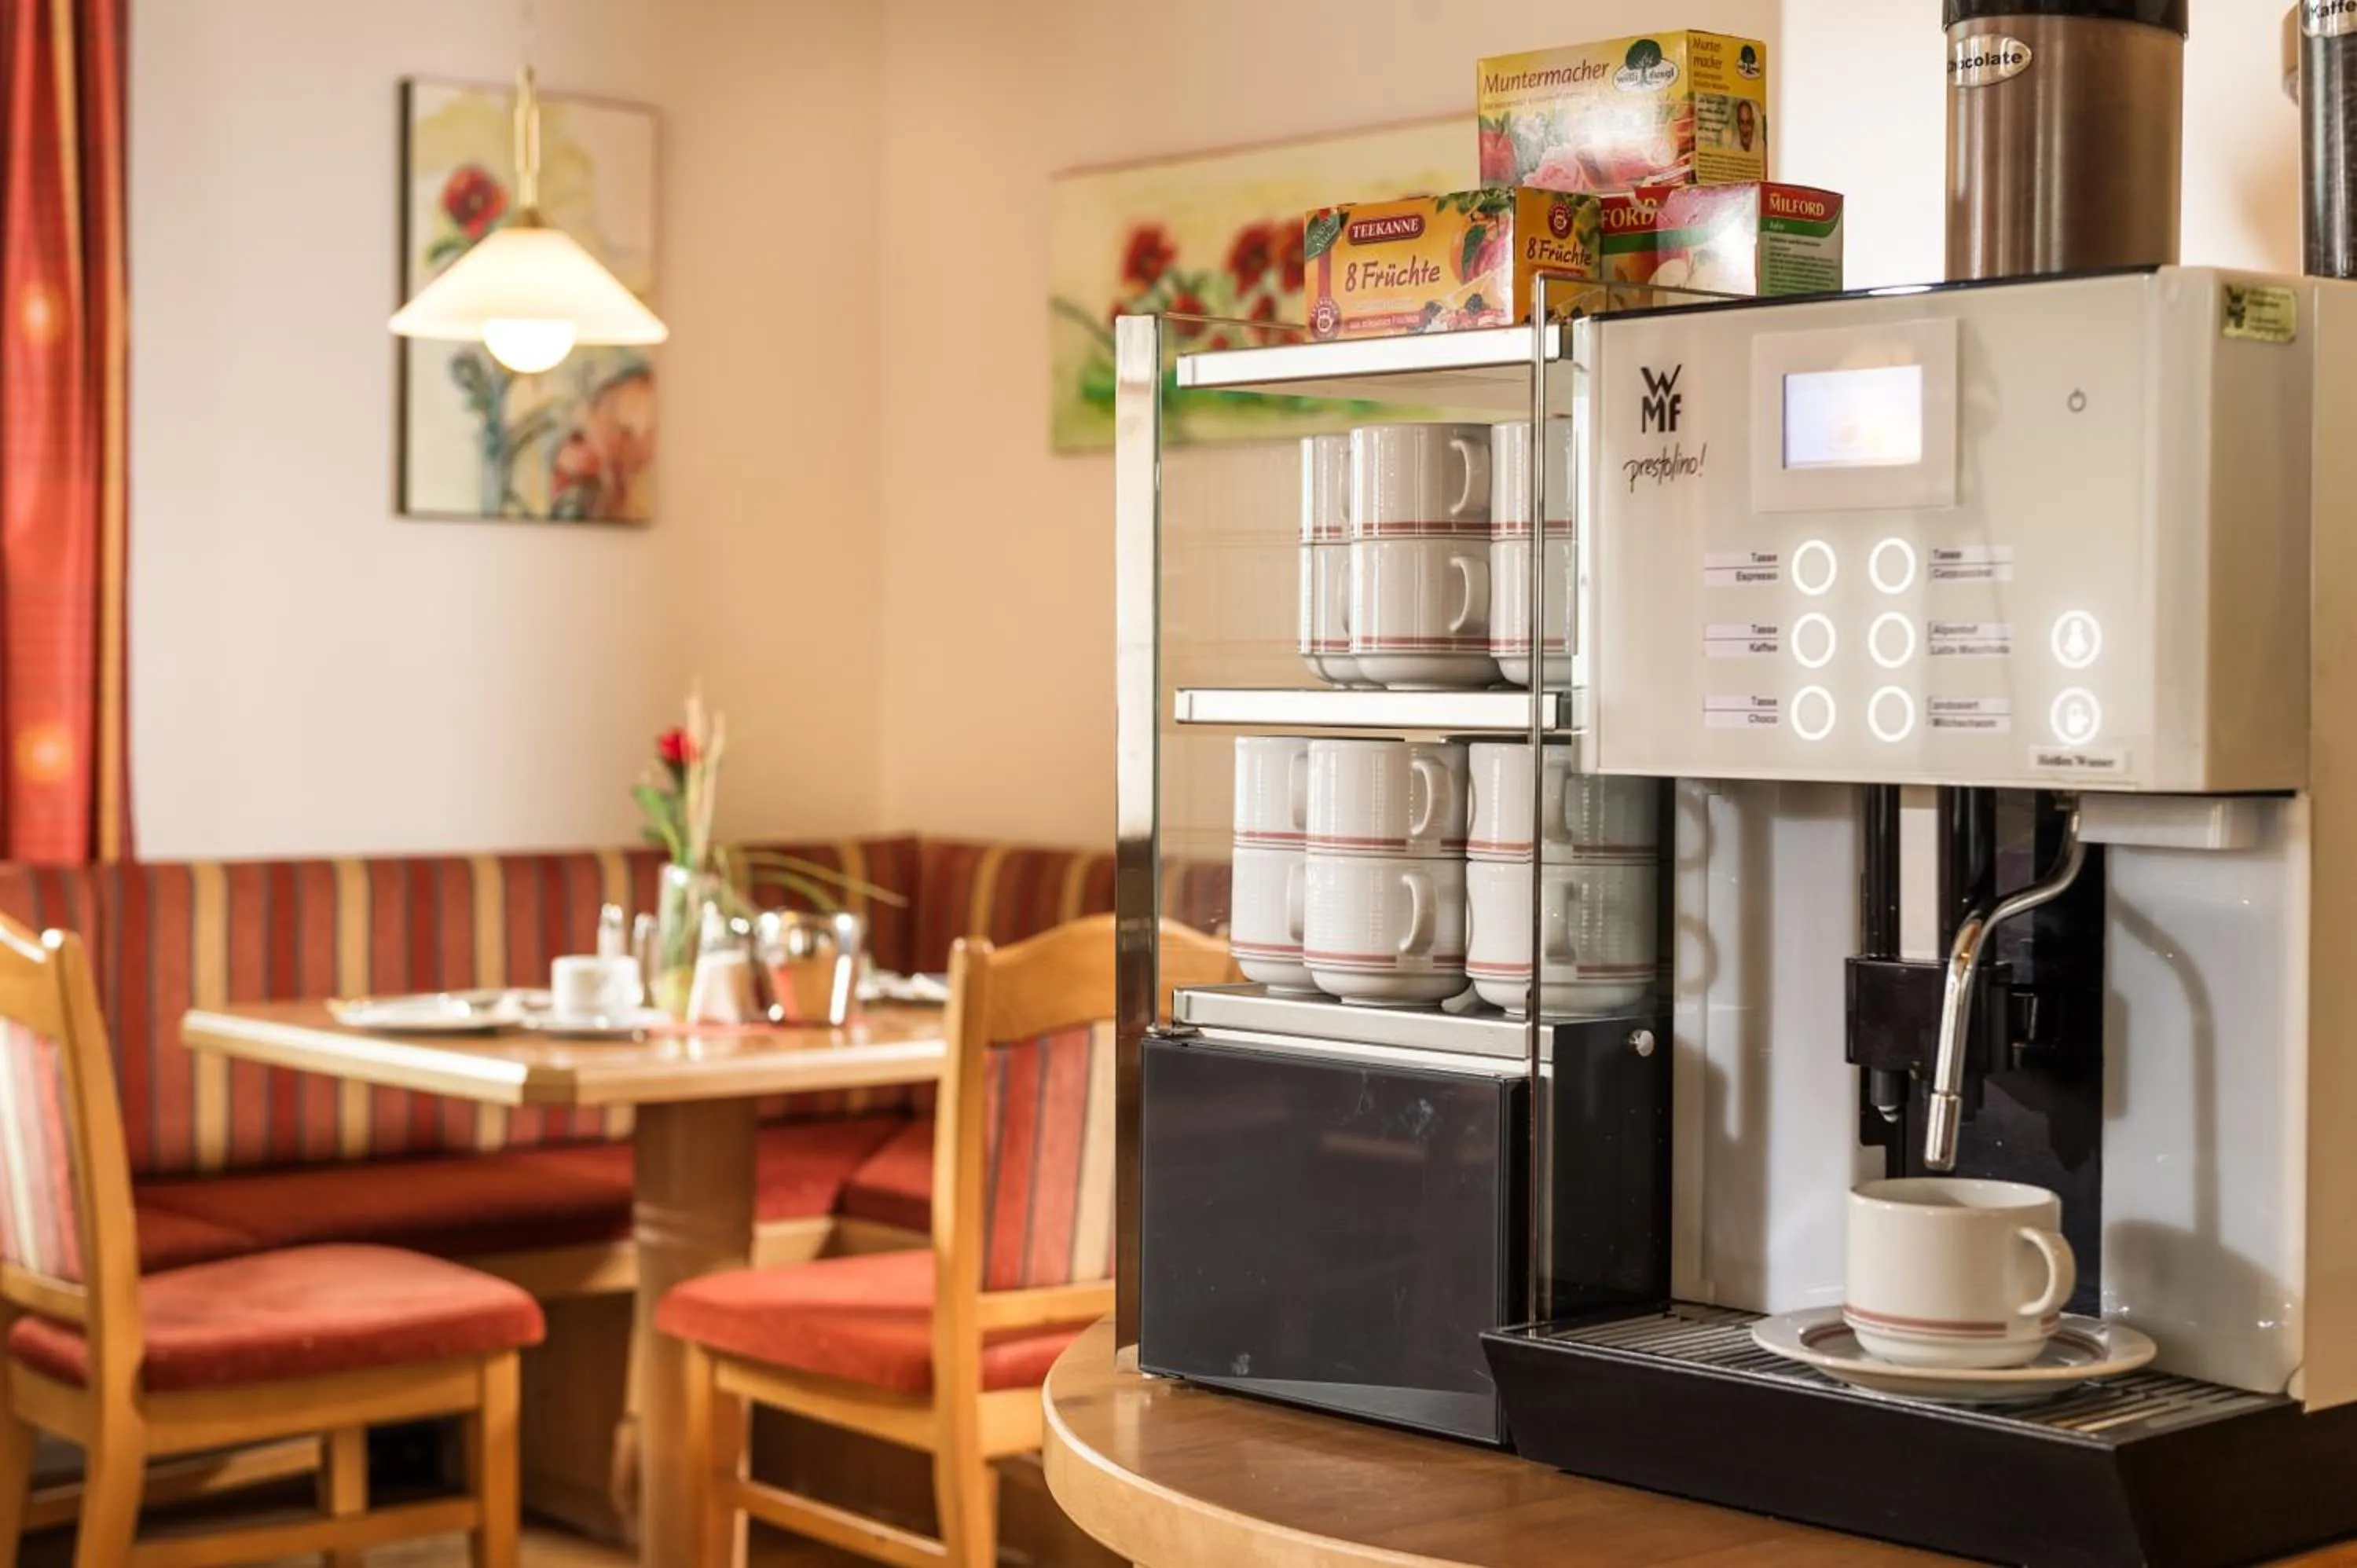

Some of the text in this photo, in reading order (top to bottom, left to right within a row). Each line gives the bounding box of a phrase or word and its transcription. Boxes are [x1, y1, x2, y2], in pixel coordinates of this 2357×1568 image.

[1483, 59, 1610, 94] Muntermacher
[1769, 193, 1825, 216] MILFORD
[1352, 218, 1420, 238] TEEKANNE
[1527, 237, 1592, 266] 8 Früchte
[1345, 255, 1440, 292] 8 Früchte
[1736, 571, 1777, 582] Espresso
[1749, 642, 1777, 653] Kaffee
